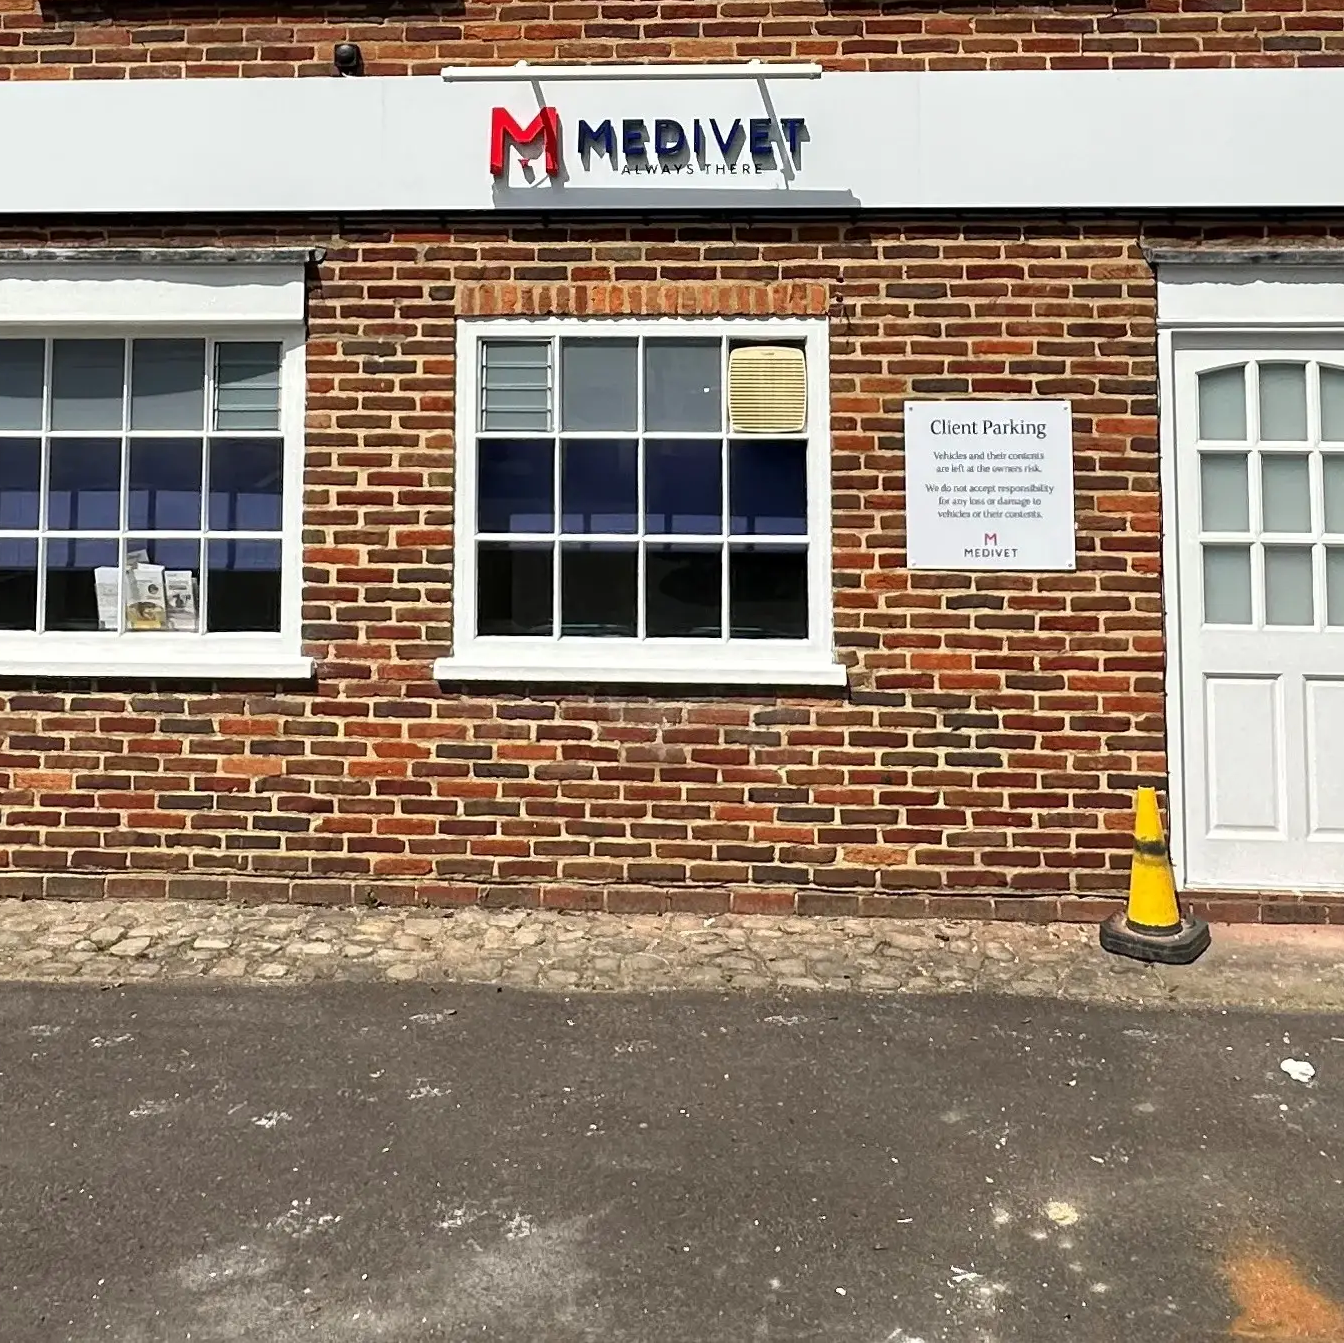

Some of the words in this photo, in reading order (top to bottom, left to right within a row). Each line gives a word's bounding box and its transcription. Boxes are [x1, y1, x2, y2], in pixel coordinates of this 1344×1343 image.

[577, 118, 805, 156] MEDIVET
[621, 163, 695, 175] ALWAYS
[704, 163, 763, 175] THERE
[930, 419, 978, 435] Client
[982, 419, 1047, 439] Parking
[933, 451, 968, 460] Vehicles
[968, 451, 985, 460] and
[986, 451, 1006, 460] their
[1008, 451, 1045, 460] contents
[951, 464, 965, 473] left
[966, 465, 974, 473] at
[976, 464, 991, 473] the
[925, 484, 940, 493] We
[941, 484, 952, 493] do
[953, 485, 968, 493] not
[969, 485, 996, 495] accept
[998, 484, 1055, 495] responsibility
[938, 497, 950, 506] for
[952, 499, 967, 507] any
[969, 497, 986, 506] loss
[997, 497, 1031, 507] damage
[1032, 498, 1042, 506] to
[938, 510, 971, 519] vehicles
[983, 510, 1003, 519] their
[964, 548, 1018, 558] MEDIVET
